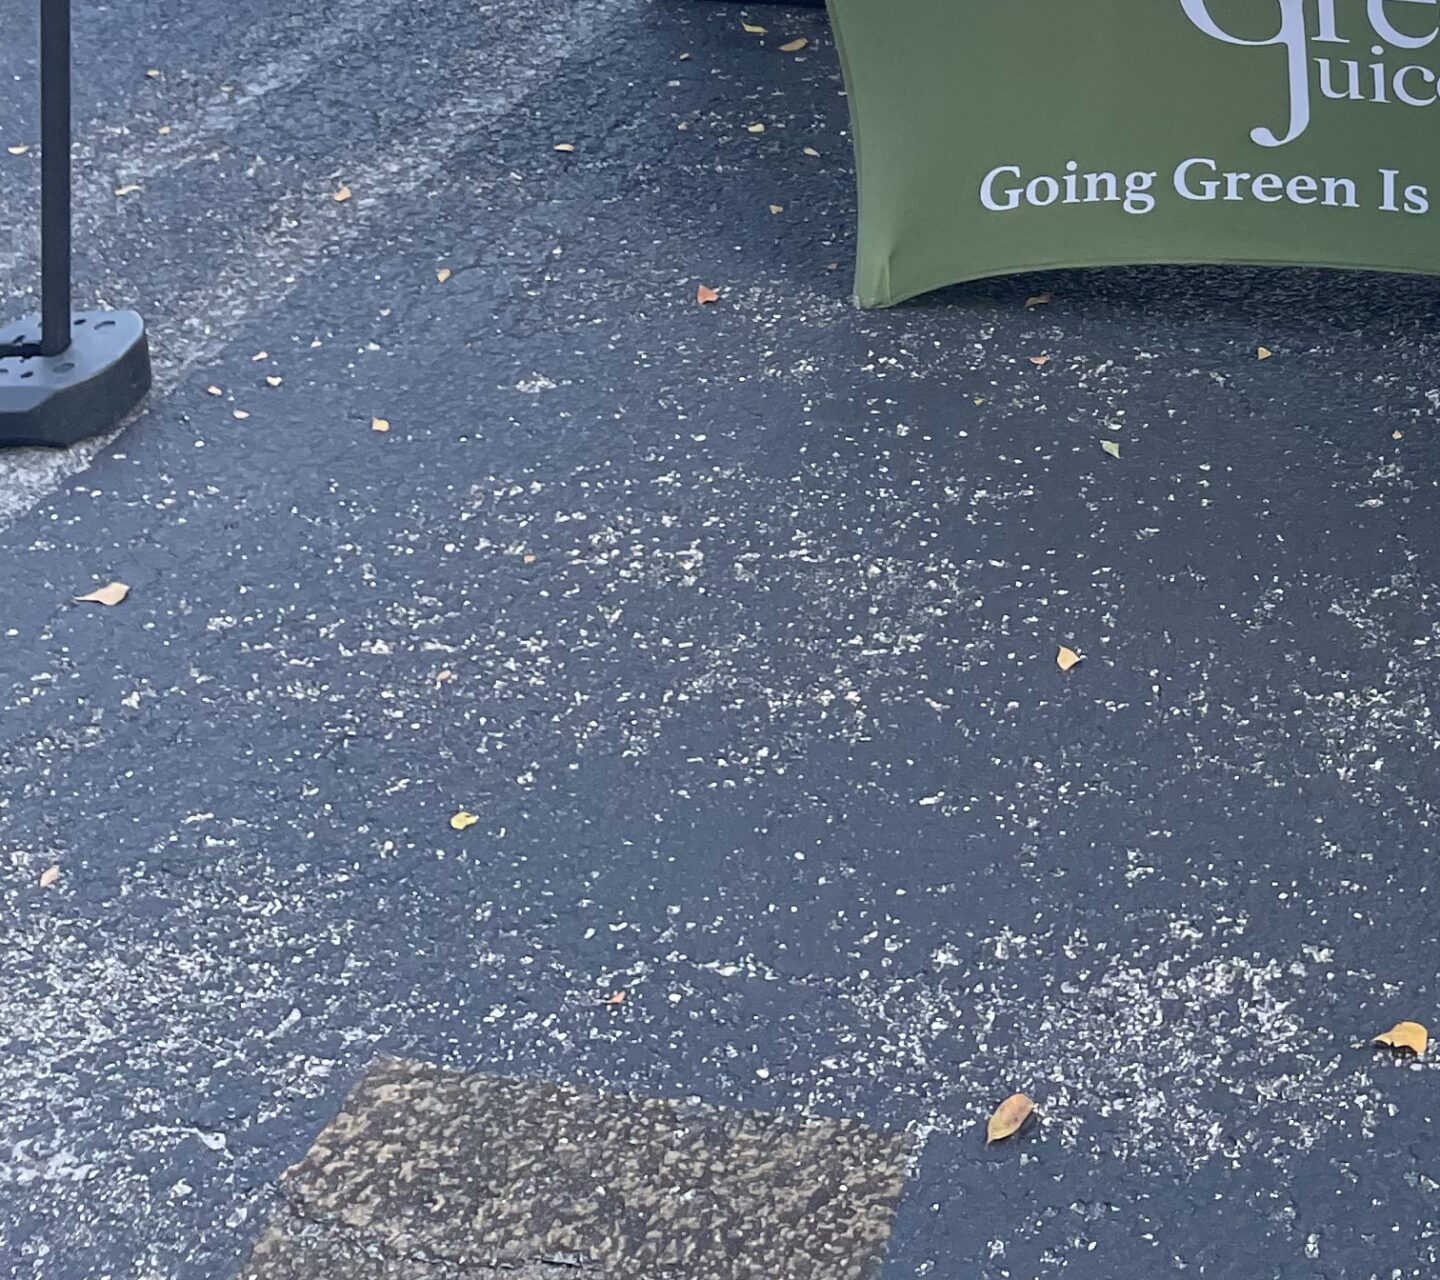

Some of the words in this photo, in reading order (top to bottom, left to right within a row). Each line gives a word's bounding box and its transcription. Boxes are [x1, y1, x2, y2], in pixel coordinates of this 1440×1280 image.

[979, 160, 1157, 215] Going
[1172, 156, 1360, 209] Green
[1377, 168, 1430, 215] Is
